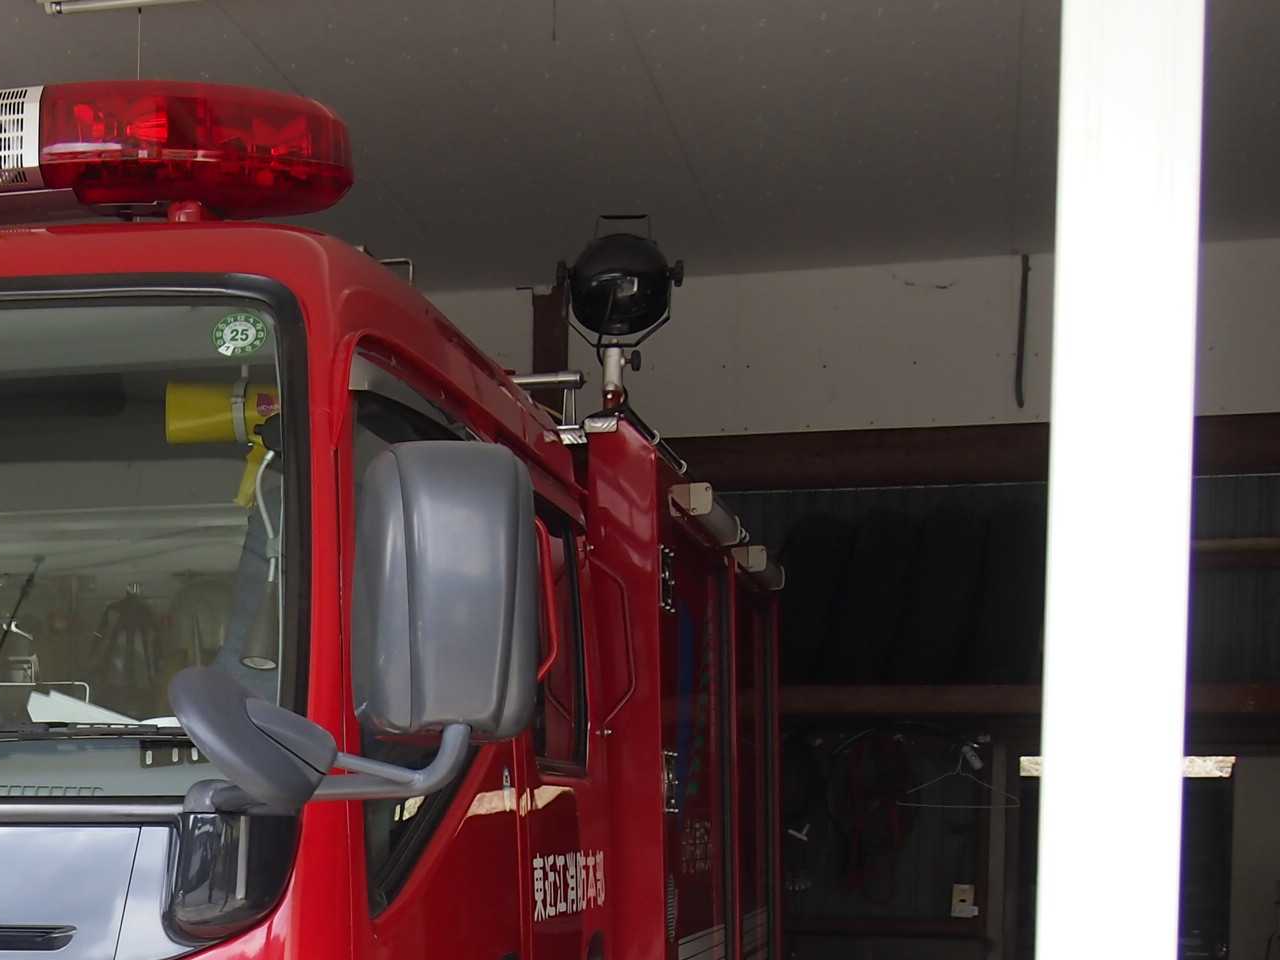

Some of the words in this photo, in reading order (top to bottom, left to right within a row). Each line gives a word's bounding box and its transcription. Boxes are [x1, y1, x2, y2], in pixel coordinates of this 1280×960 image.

[229, 328, 249, 342] 25
[532, 849, 606, 922] 東近江消防本部
